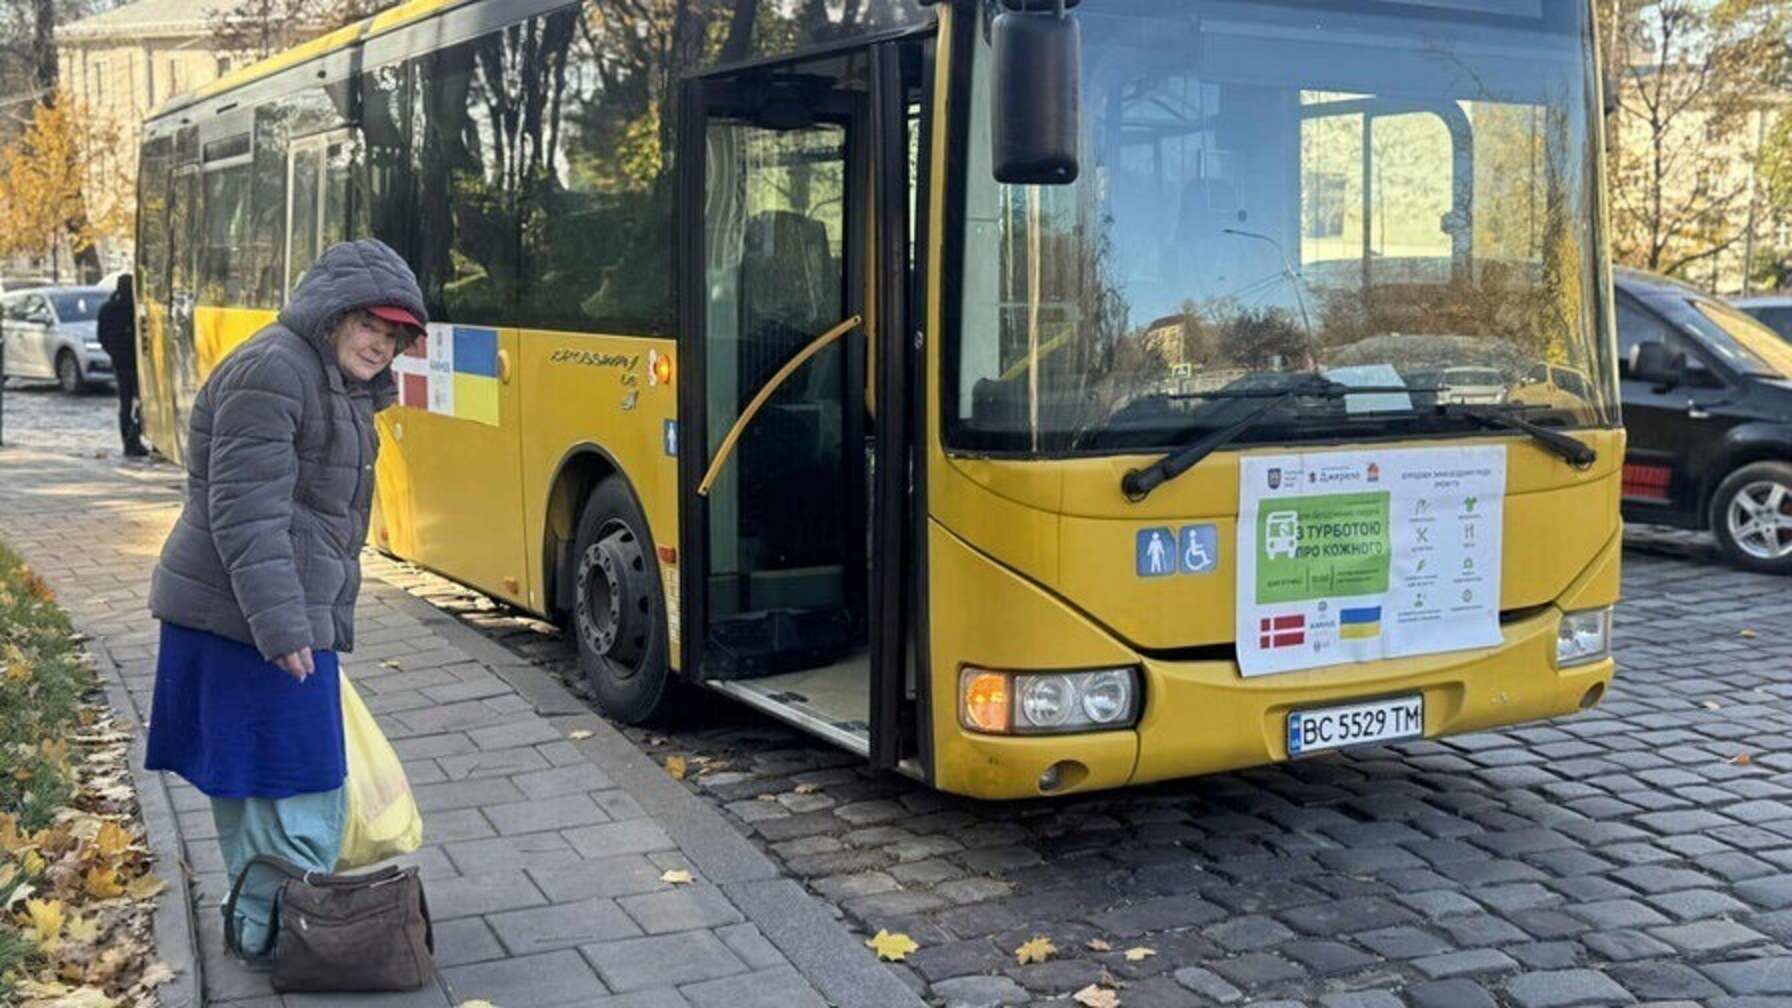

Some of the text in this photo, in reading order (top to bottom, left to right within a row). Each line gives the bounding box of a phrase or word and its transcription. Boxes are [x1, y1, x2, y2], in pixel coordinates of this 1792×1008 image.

[1307, 521, 1381, 539] ТУРБОТОЮ
[1296, 541, 1382, 558] ПРО КОЖНОГО
[1303, 705, 1419, 745] BC 5529 TM
